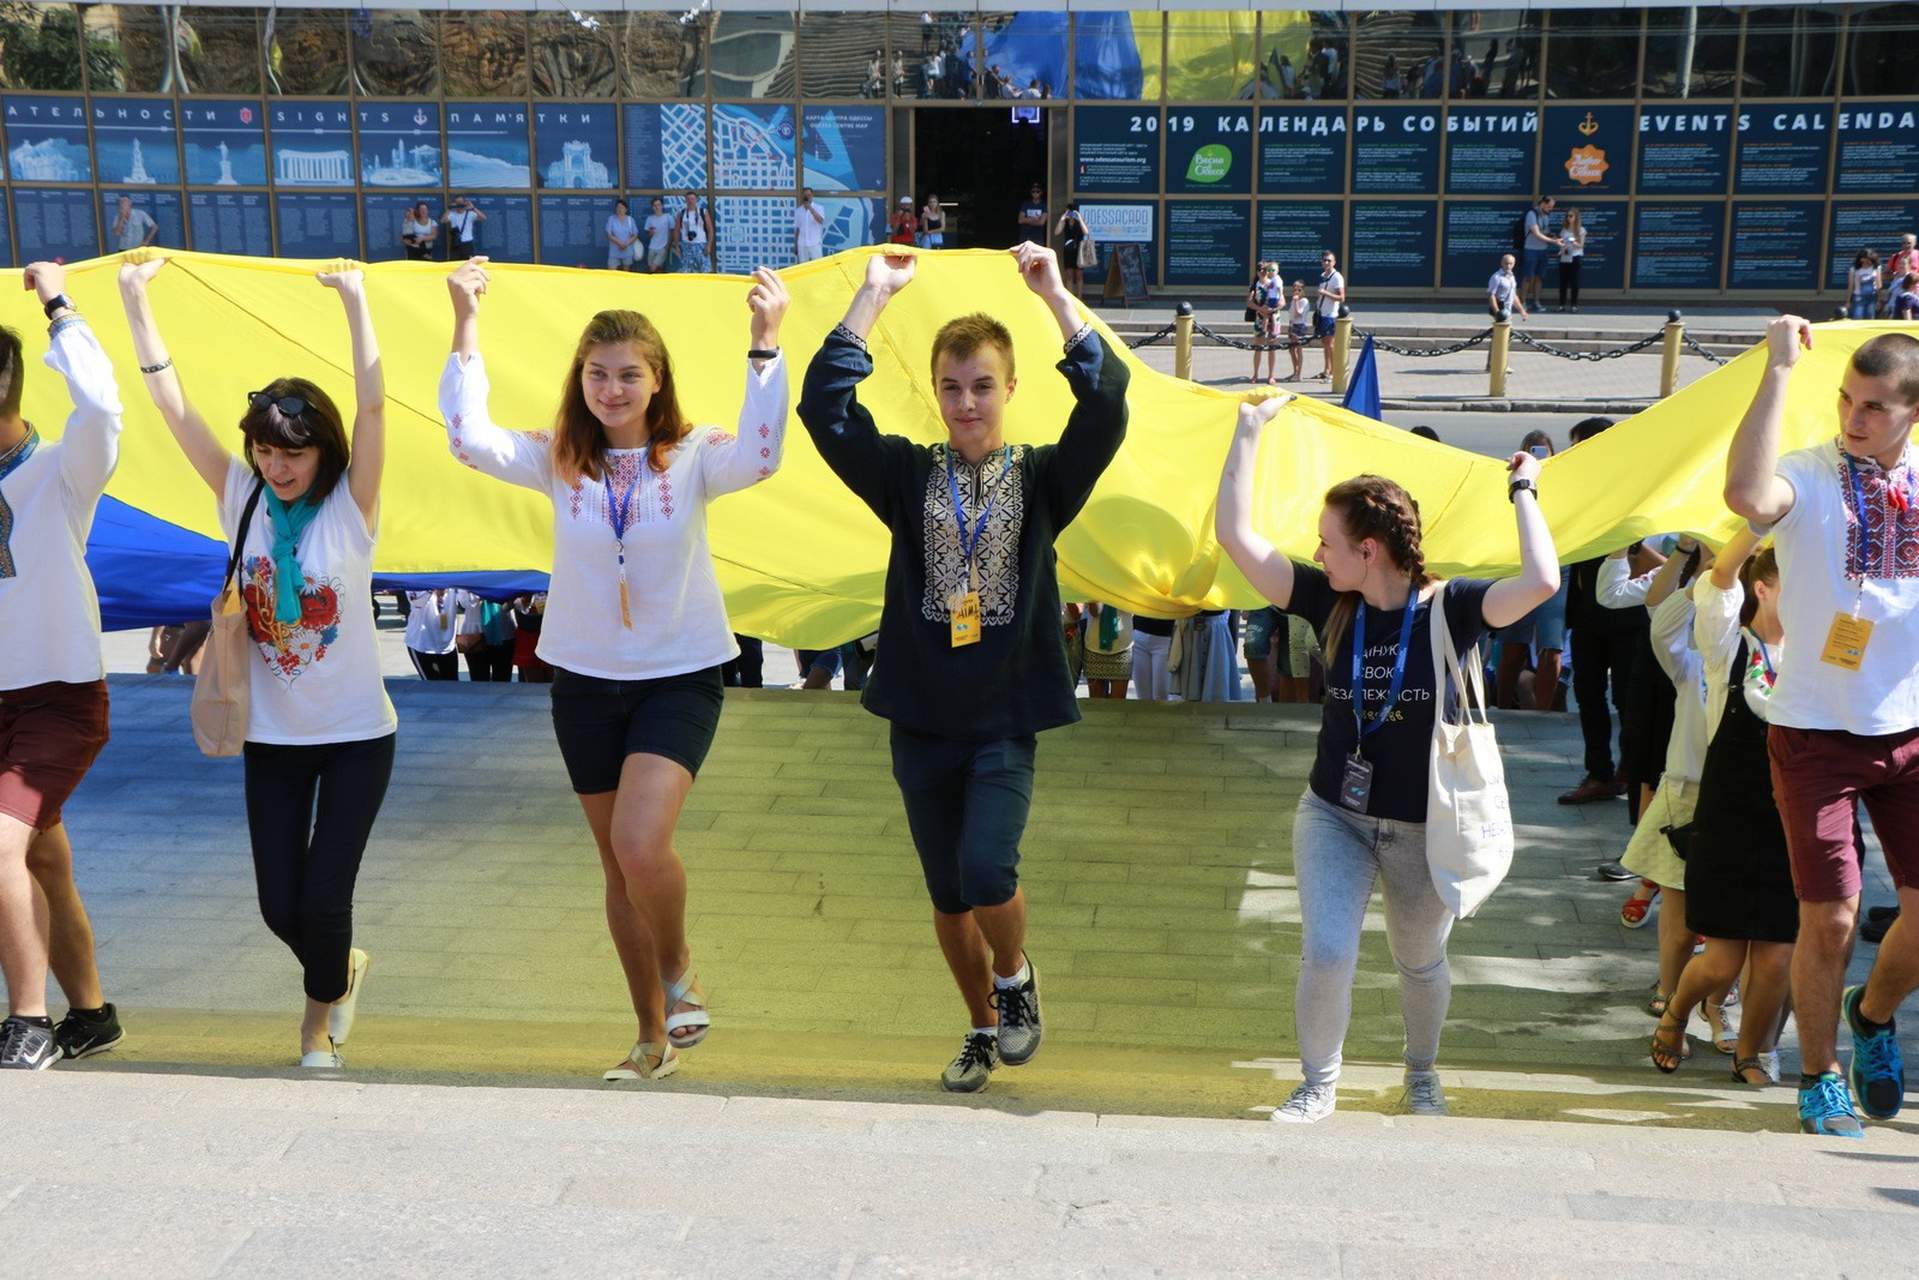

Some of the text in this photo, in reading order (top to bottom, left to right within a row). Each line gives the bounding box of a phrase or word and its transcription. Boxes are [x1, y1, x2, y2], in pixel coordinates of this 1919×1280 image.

[277, 111, 389, 122] SIGHTS
[451, 113, 590, 124] ПАМ'ЯТКИ
[1130, 112, 1539, 136] 2019 КАЛЕНДАРЬ СОБЫТИЙ
[1639, 112, 1915, 131] EVENTS CALENDA
